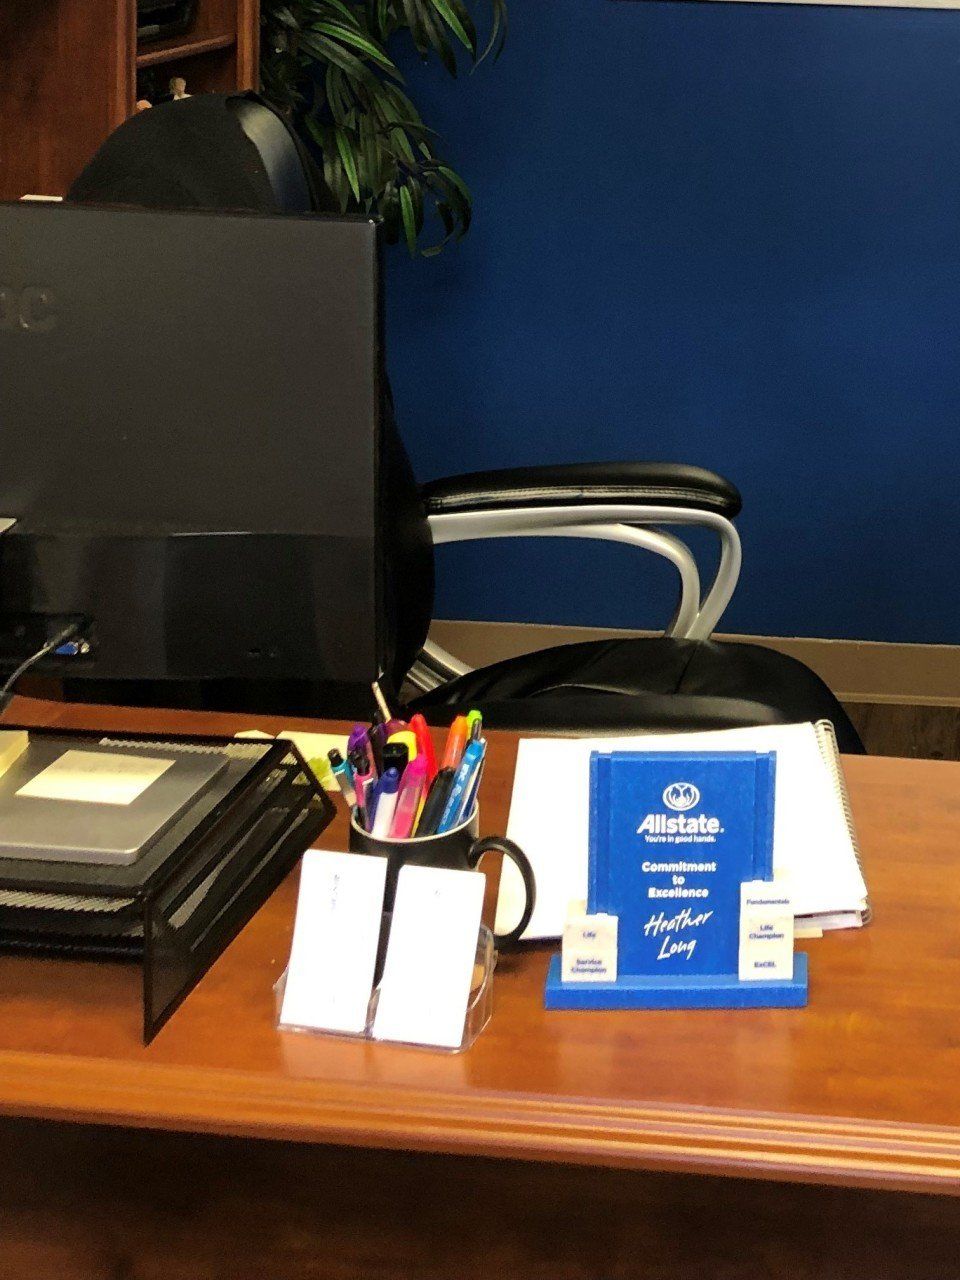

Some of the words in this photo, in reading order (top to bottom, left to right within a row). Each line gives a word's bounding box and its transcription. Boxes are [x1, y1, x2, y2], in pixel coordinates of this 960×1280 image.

[667, 834, 675, 842] in
[675, 835, 693, 844] good
[641, 861, 717, 872] Commitment
[672, 874, 686, 886] to
[648, 886, 709, 898] Excellence
[643, 907, 714, 937] Heather
[656, 935, 698, 961] Long
